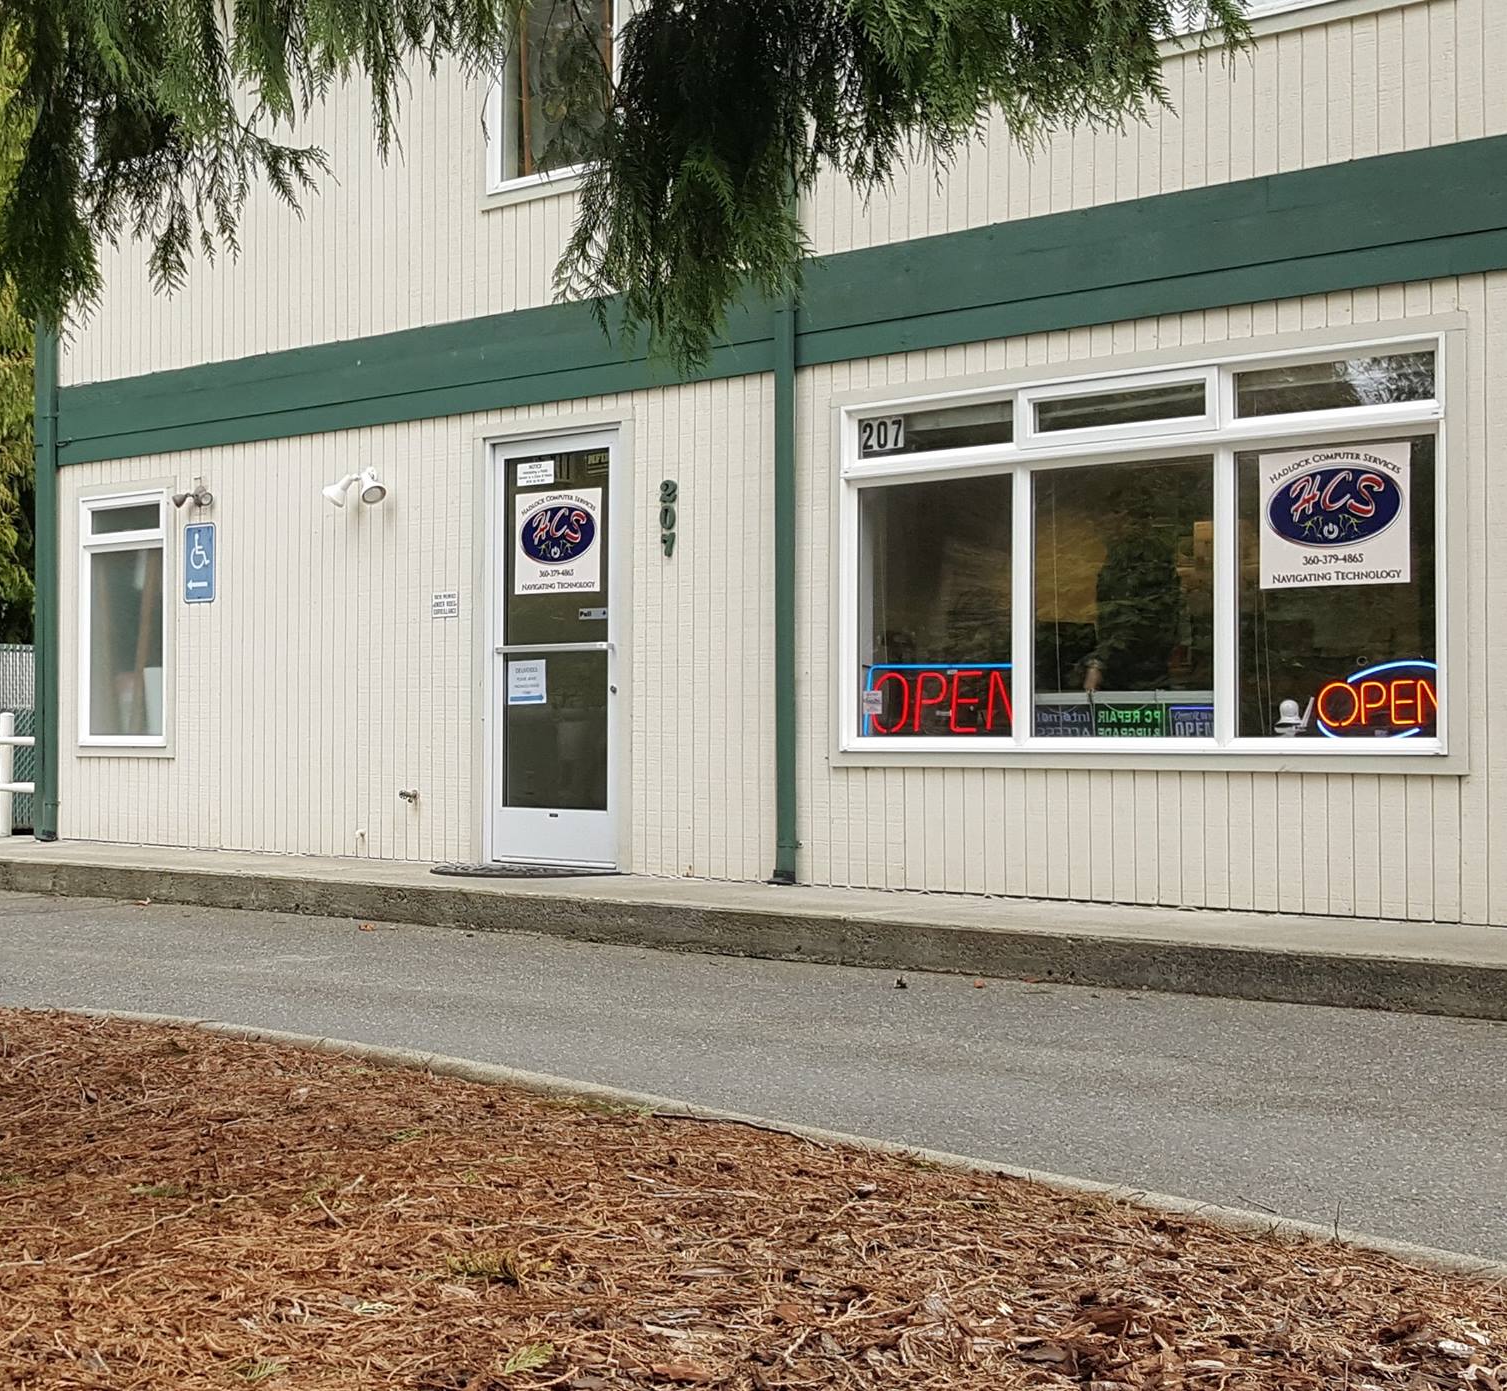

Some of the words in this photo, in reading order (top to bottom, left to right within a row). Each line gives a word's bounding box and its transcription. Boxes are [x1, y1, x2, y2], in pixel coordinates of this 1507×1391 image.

[862, 418, 903, 450] 207
[1269, 457, 1312, 484] HADLOCK
[1312, 451, 1361, 463] COMPUTER
[1364, 453, 1402, 474] SERVICES
[521, 497, 545, 516] HADLOCK
[574, 495, 596, 511] SERVICES
[1289, 470, 1385, 522] HCS
[532, 507, 587, 545] HCS
[659, 479, 678, 557] 207
[539, 568, 575, 578] 360-379-4865
[1302, 553, 1364, 566] 360-379-4865
[521, 582, 556, 591] NAVIGATING
[557, 580, 596, 590] TECHNOLOGY
[1272, 572, 1332, 584] NAVIGATING
[1334, 569, 1402, 581] TECHNOLOGY
[871, 671, 1013, 733] OPEN
[1317, 680, 1438, 727] OPEN
